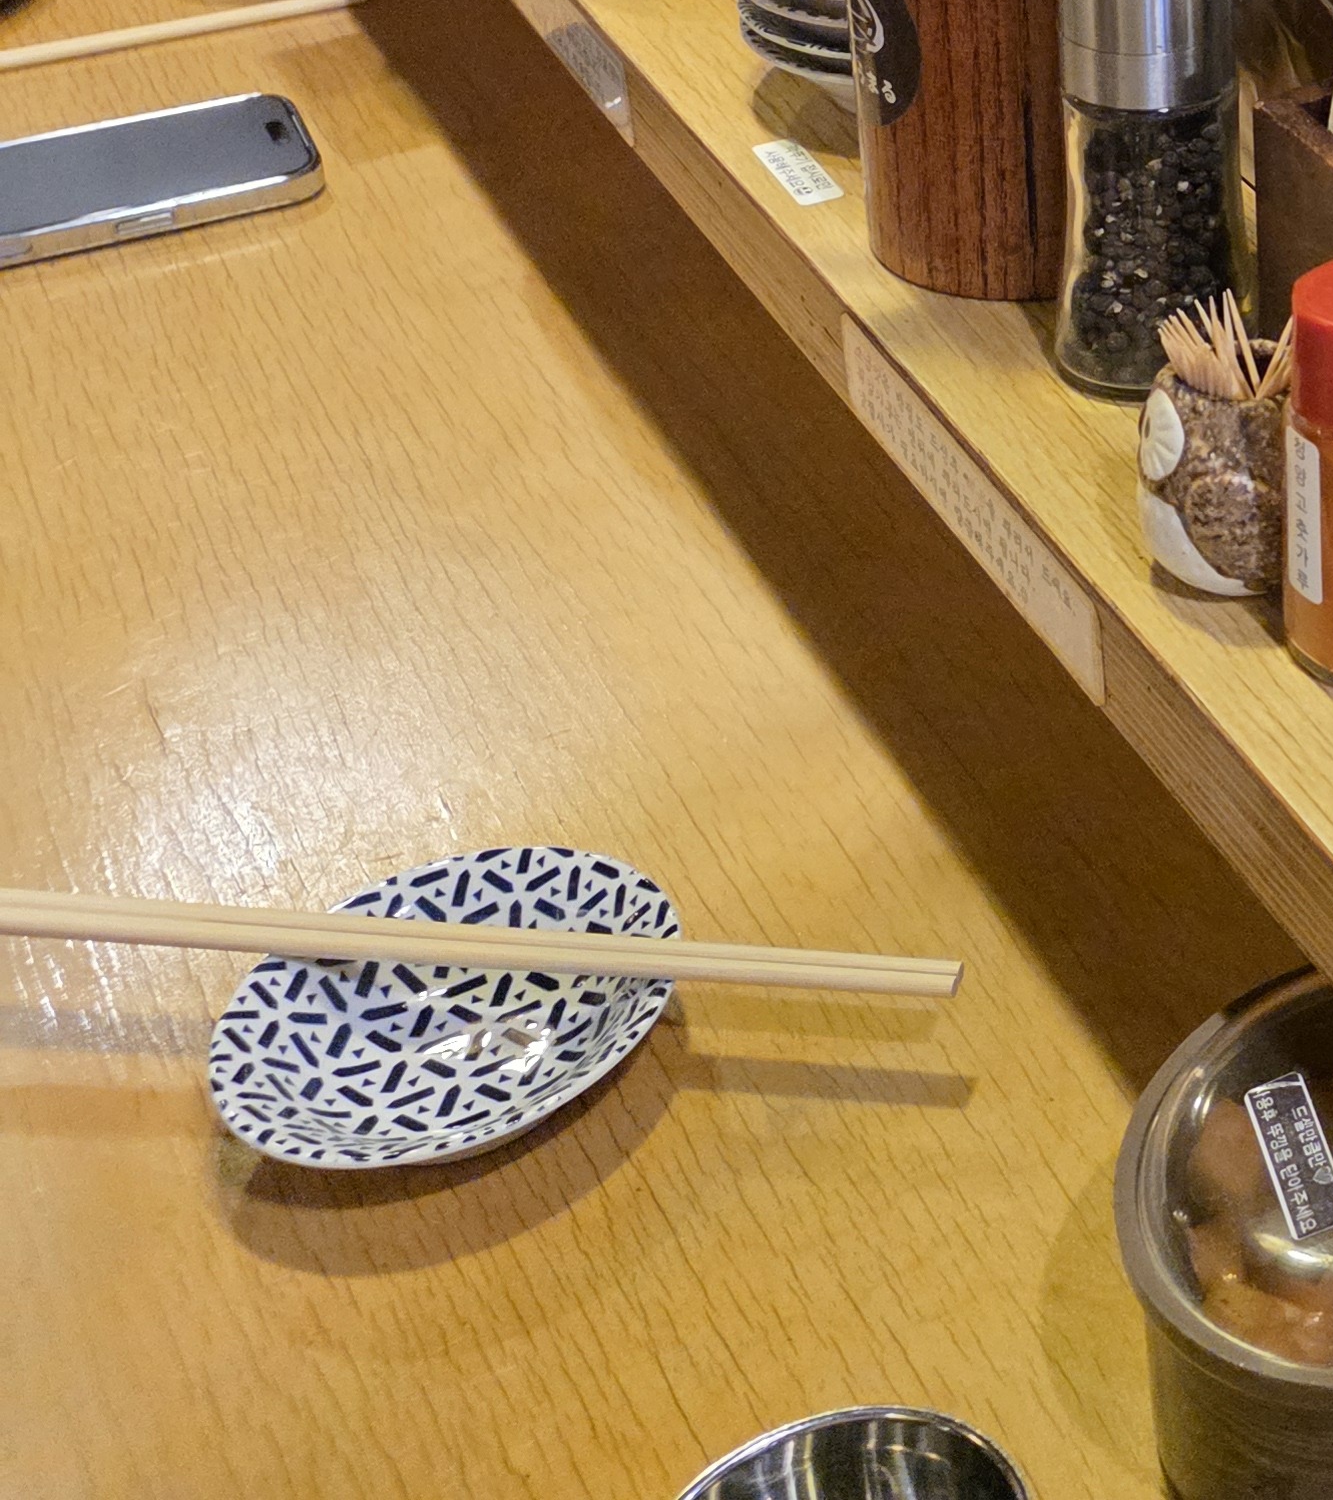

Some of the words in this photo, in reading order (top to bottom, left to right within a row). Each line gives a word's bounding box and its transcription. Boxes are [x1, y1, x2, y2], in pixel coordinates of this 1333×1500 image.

[766, 151, 805, 187] 사용해주세요
[1291, 1105, 1328, 1168] 드실만큼만
[1266, 1122, 1293, 1164] 뚜껑을
[1280, 1163, 1317, 1234] 닫아주세요
